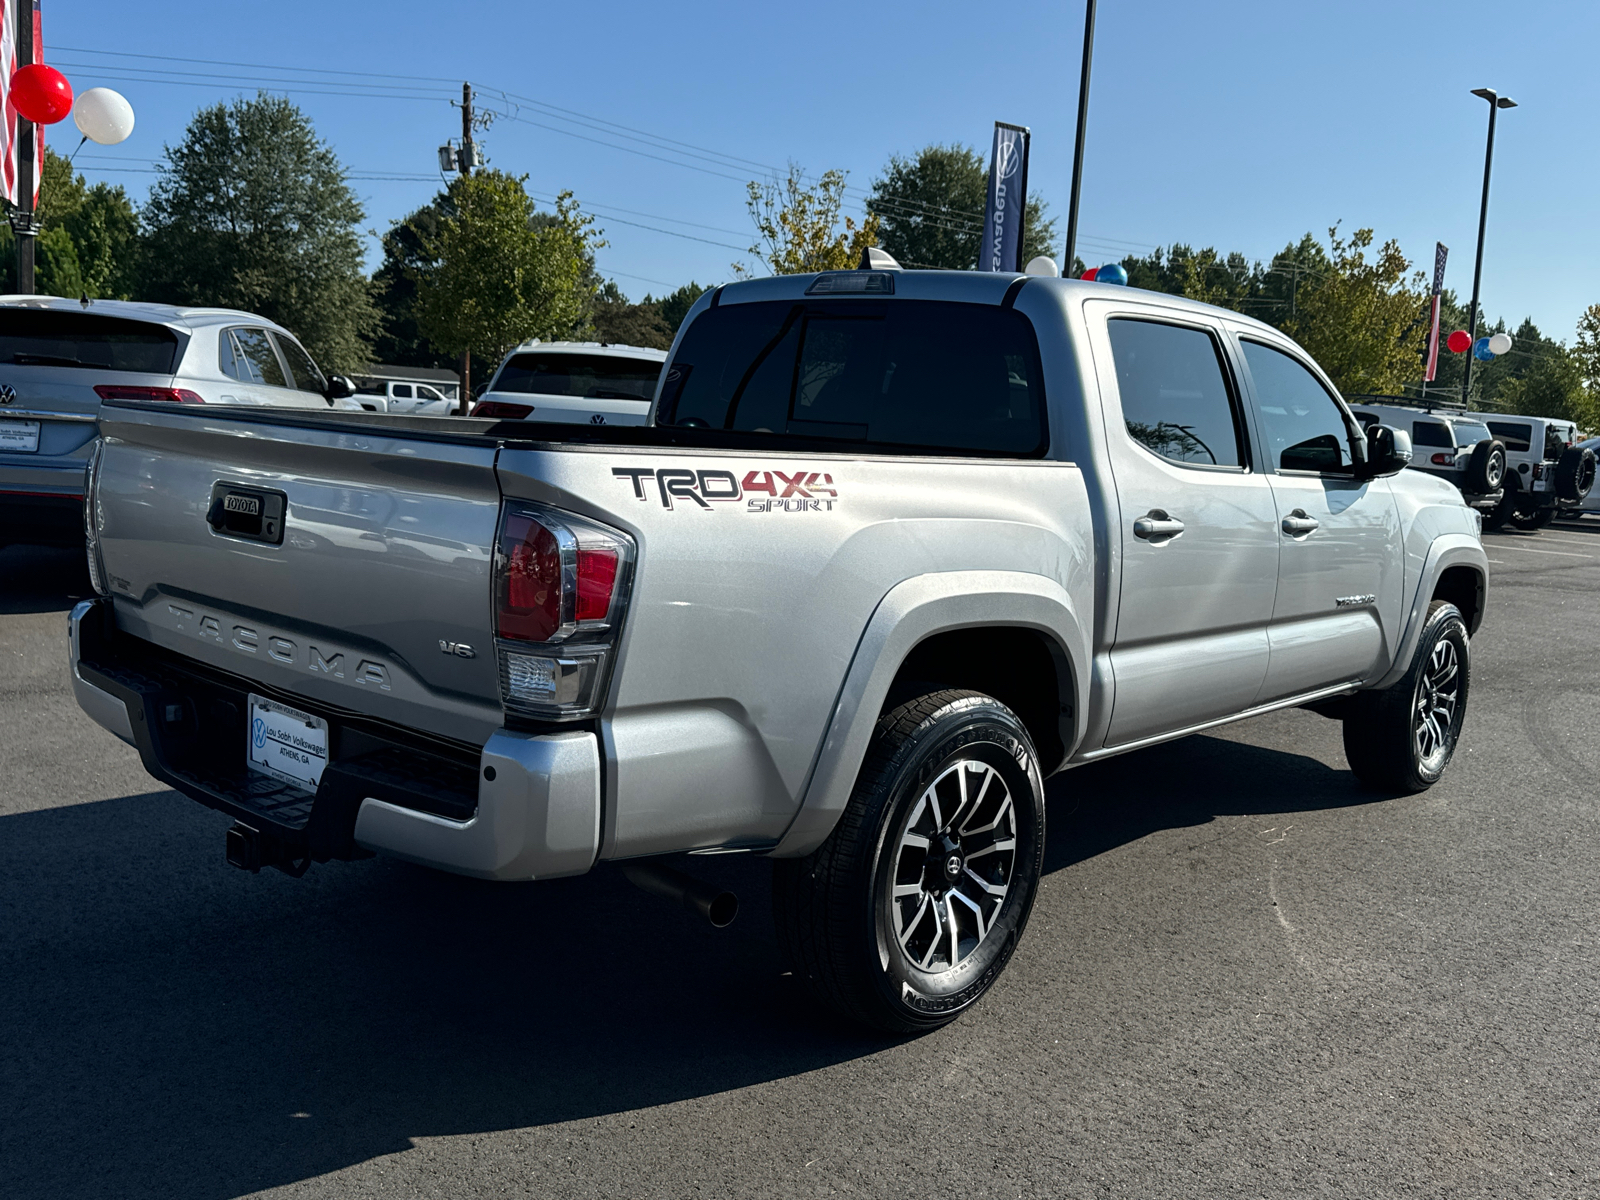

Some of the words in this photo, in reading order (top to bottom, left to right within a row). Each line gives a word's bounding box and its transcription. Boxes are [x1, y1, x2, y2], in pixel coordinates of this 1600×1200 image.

[611, 467, 743, 511] TRD
[226, 496, 258, 514] TOYOTA
[747, 498, 838, 513] SPORT
[168, 604, 392, 691] TACOMA
[439, 639, 477, 660] V6
[284, 706, 311, 722] VOLKSWAGEN
[266, 725, 277, 737] Lou
[277, 729, 292, 743] Sobh
[279, 746, 301, 763] ATHENS,
[302, 754, 311, 765] GA
